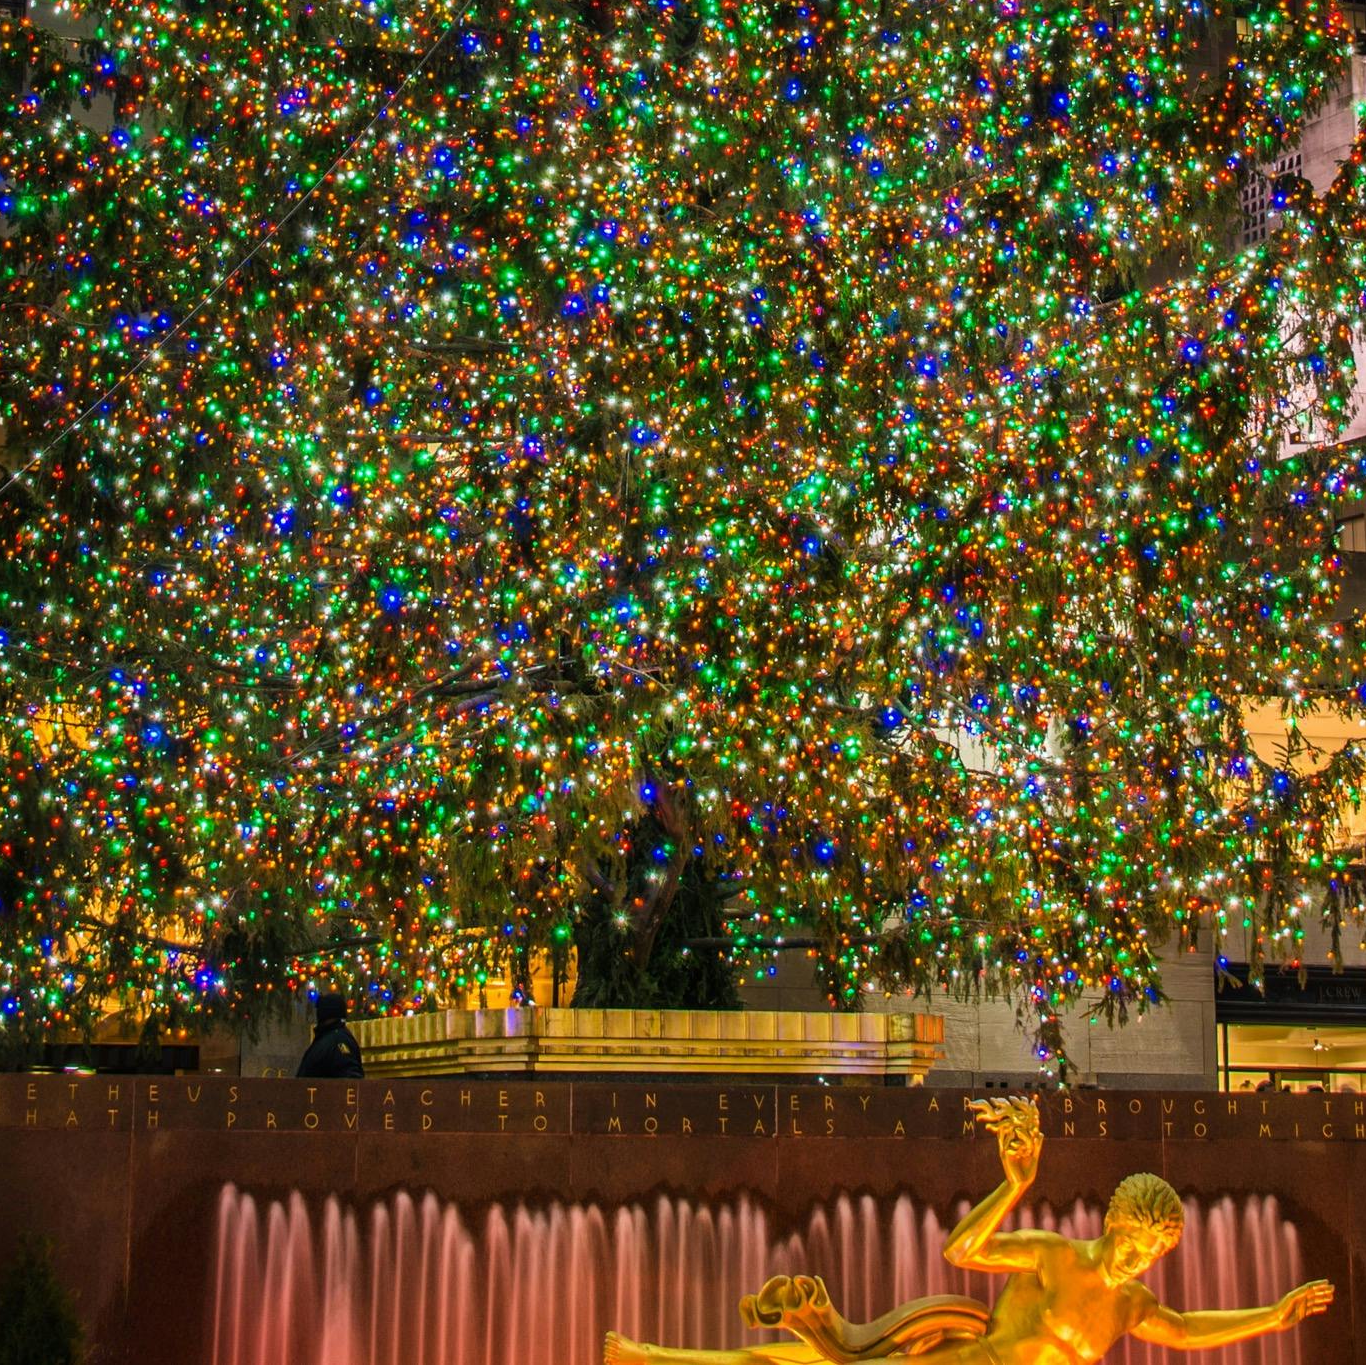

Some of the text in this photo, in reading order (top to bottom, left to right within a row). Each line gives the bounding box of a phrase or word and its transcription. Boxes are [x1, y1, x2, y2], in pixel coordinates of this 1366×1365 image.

[305, 1088, 546, 1108] TEACHER
[611, 1092, 657, 1109] IN
[718, 1094, 871, 1112] EVERY
[1064, 1098, 1271, 1115] BROUGHT
[26, 1110, 158, 1128] HATH
[227, 1112, 433, 1130] PROVED
[498, 1115, 548, 1131] TO
[608, 1117, 834, 1134] MORTALS
[894, 1121, 906, 1134] A
[962, 1121, 1107, 1136] MNS
[1165, 1122, 1207, 1138] TO
